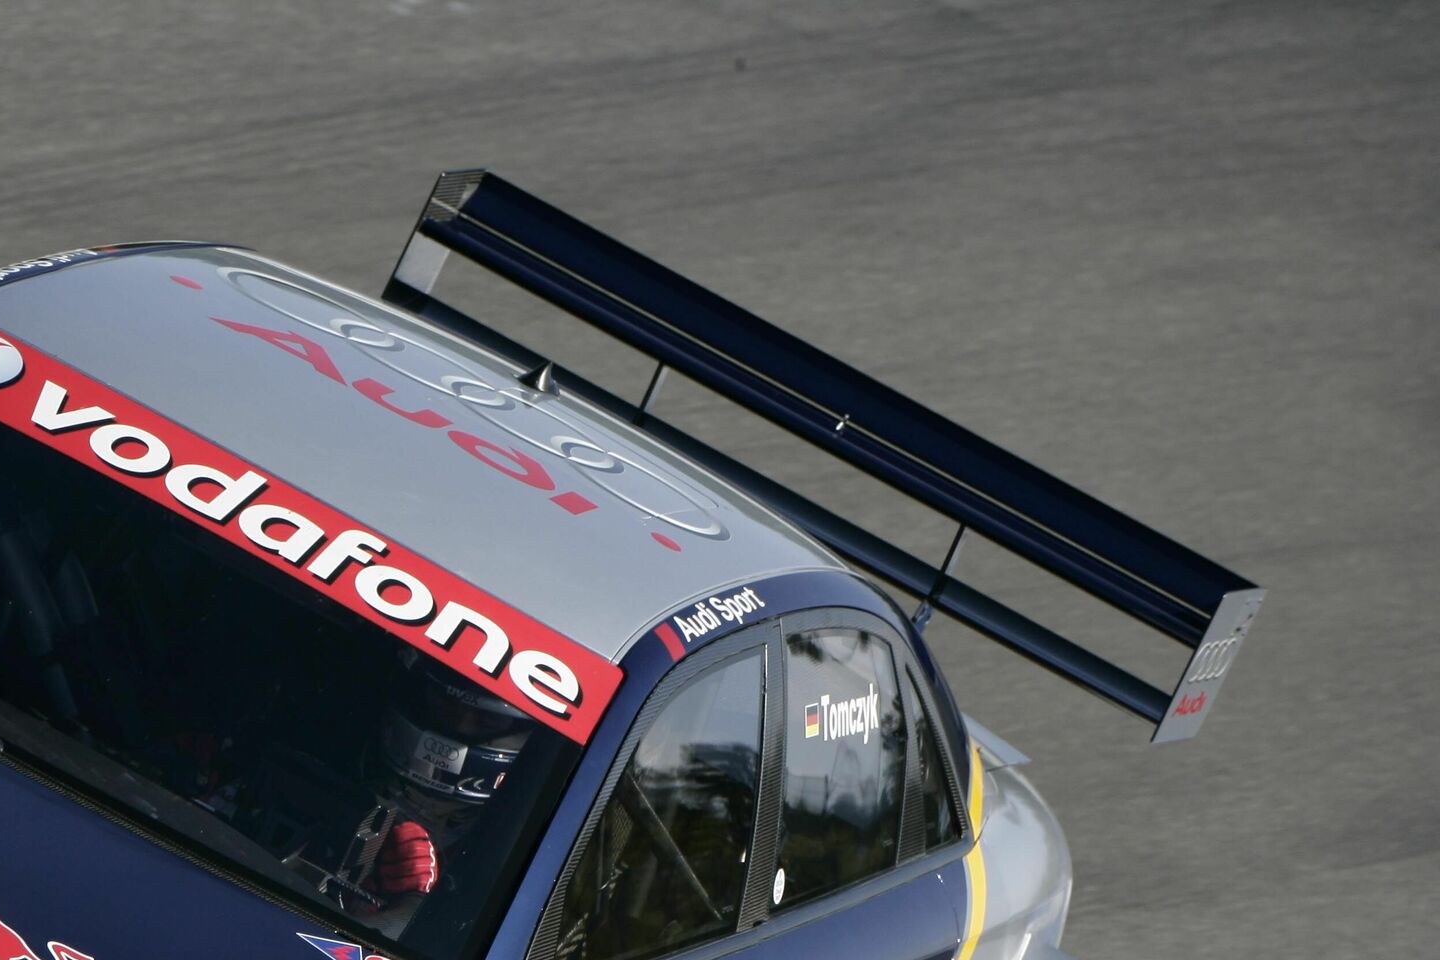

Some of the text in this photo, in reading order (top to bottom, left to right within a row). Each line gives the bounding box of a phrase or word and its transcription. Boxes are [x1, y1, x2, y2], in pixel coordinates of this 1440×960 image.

[209, 316, 600, 514] Audi
[30, 378, 583, 718] vodafone
[672, 586, 766, 643] Audi Sport
[820, 683, 880, 745] Tomczyk
[1171, 691, 1208, 718] Audi
